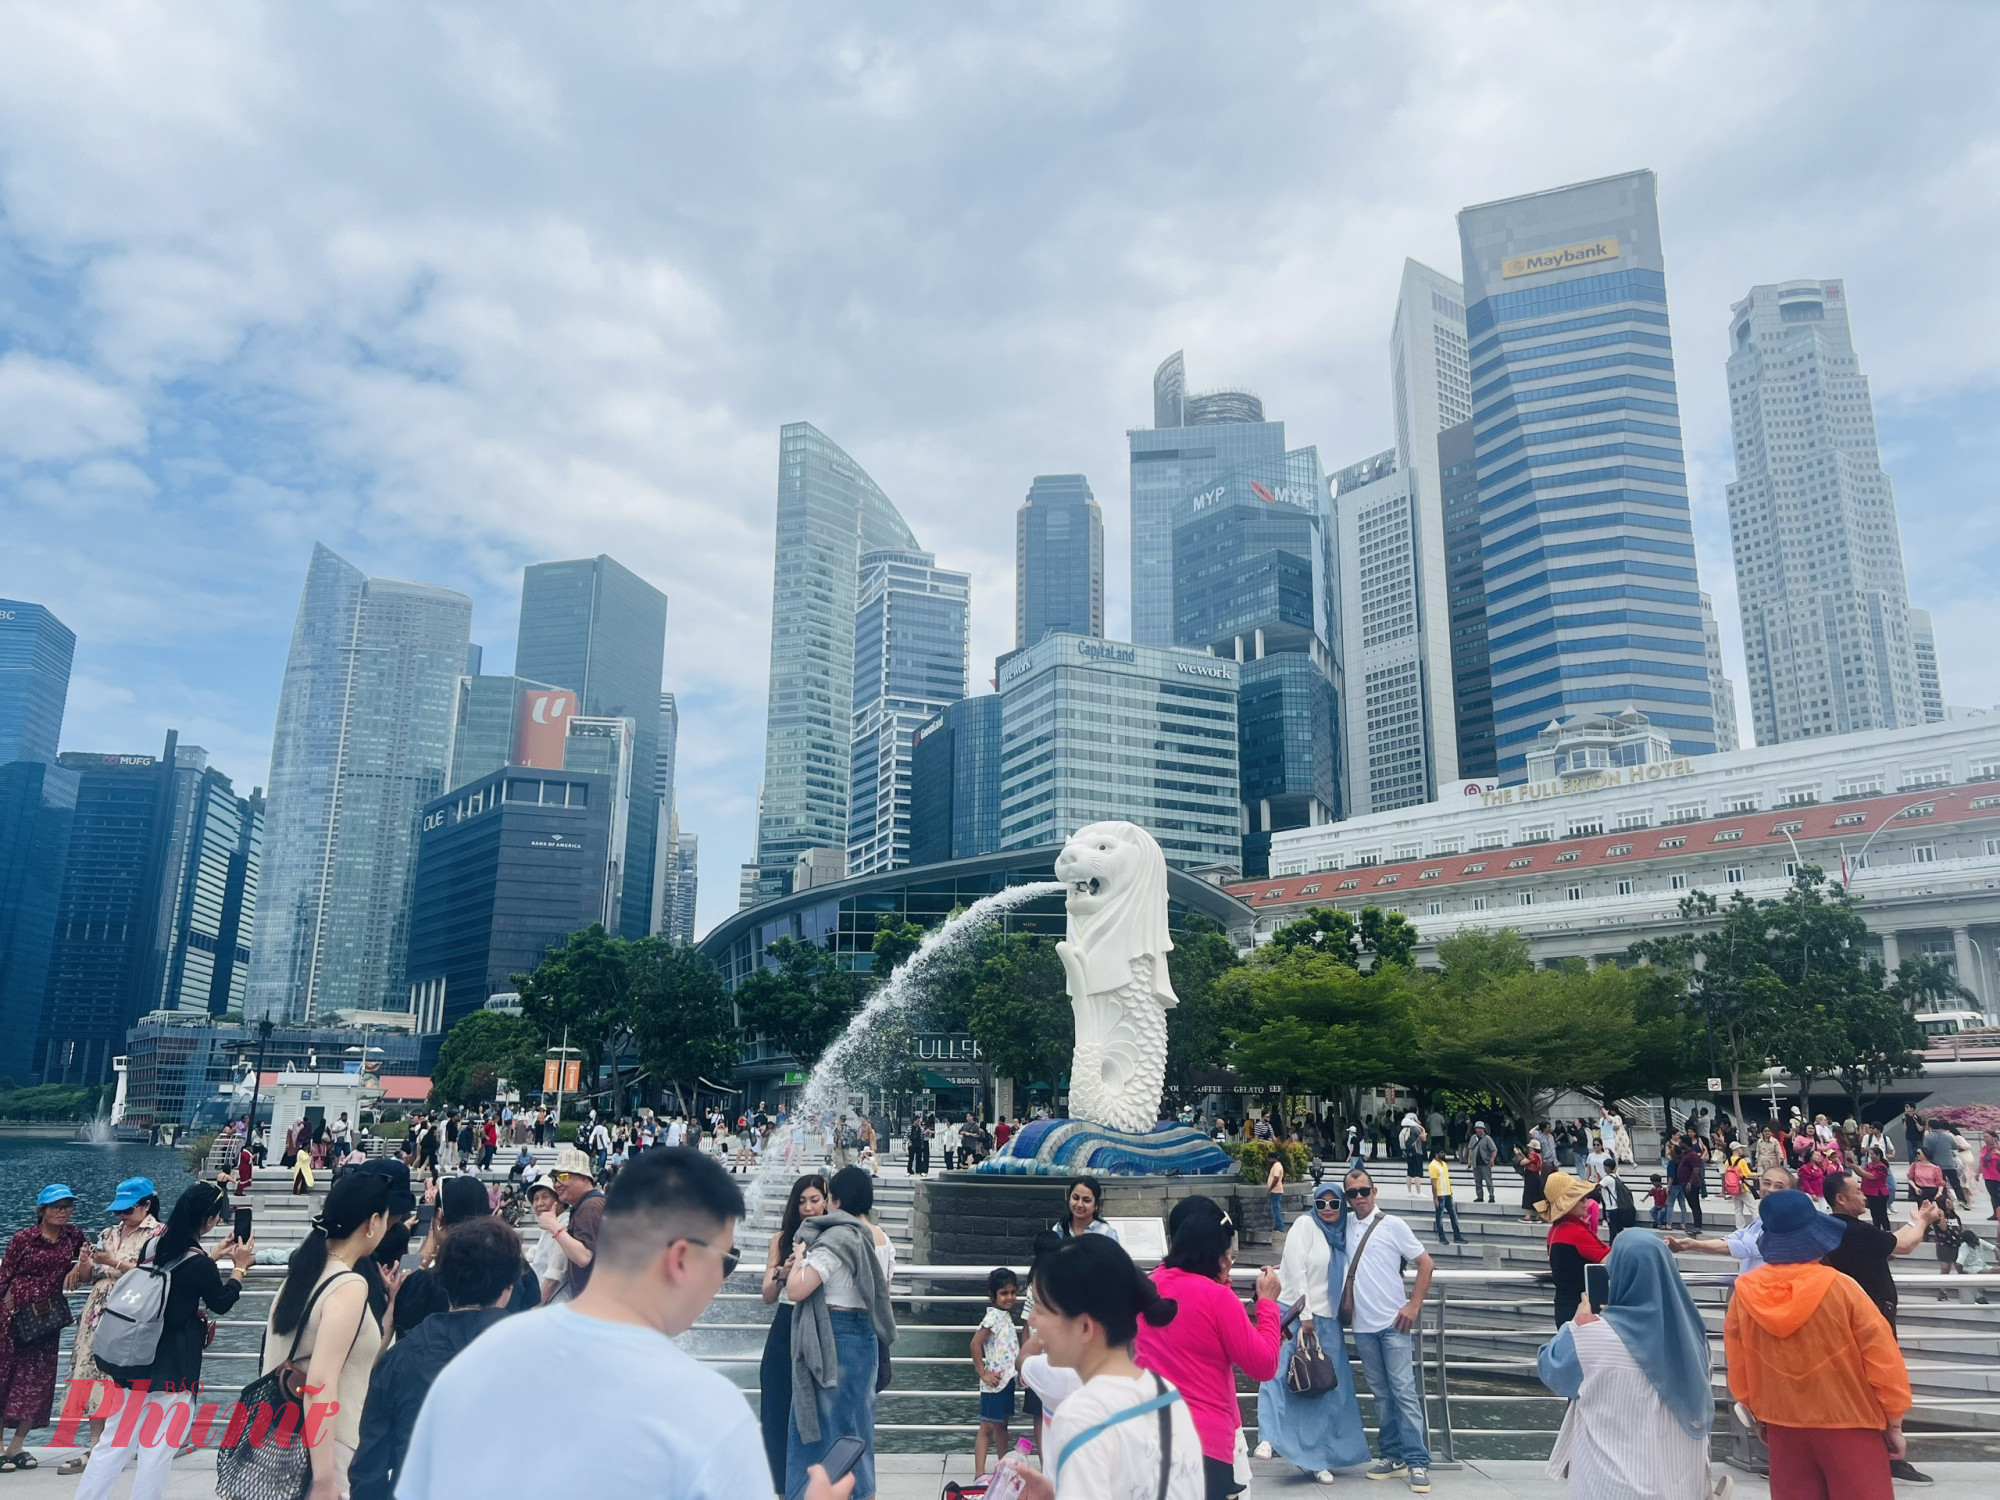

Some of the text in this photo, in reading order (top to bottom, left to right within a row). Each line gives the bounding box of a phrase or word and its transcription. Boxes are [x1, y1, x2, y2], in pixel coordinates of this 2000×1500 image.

[1526, 244, 1608, 270] Maybank
[1193, 486, 1225, 512] MYP
[1274, 487, 1314, 503] MYP
[1176, 662, 1232, 680] wework
[119, 756, 151, 766] MUFG
[1480, 759, 1695, 807] THE FULLERTON HOTEL
[423, 809, 446, 832] OUE
[1233, 1085, 1265, 1094] GELATO
